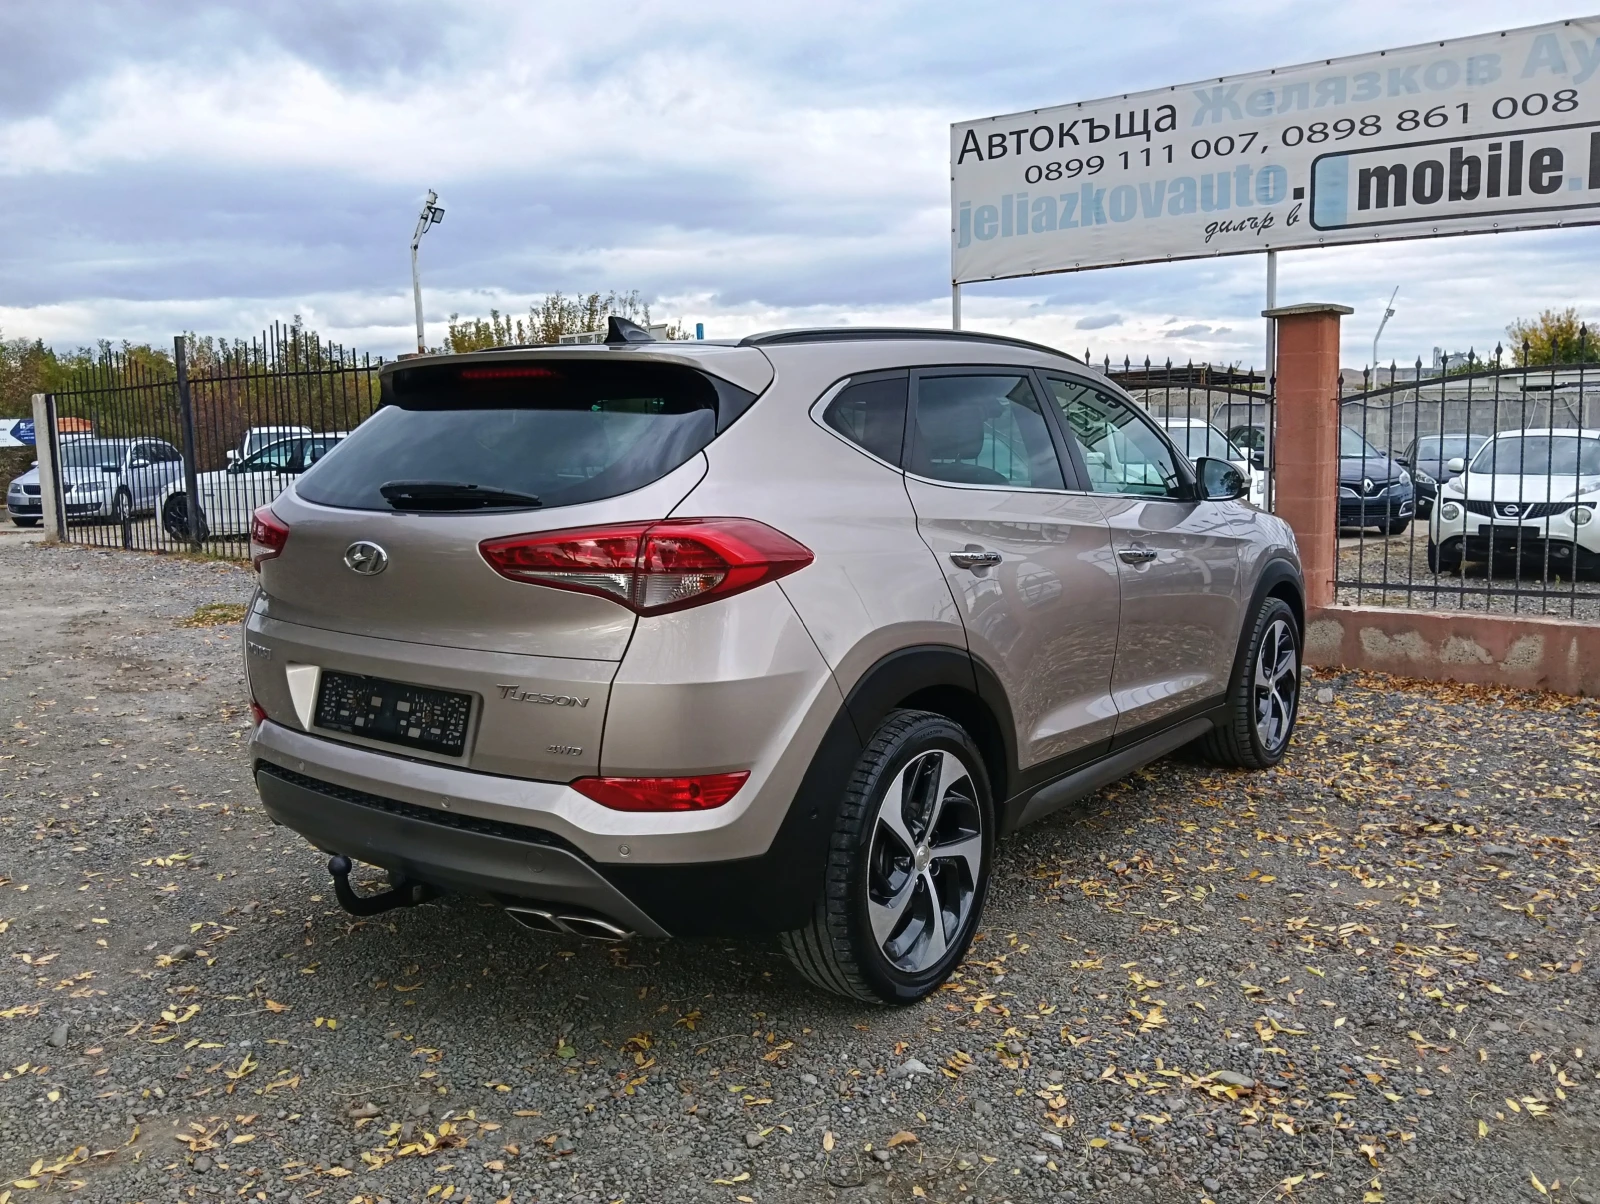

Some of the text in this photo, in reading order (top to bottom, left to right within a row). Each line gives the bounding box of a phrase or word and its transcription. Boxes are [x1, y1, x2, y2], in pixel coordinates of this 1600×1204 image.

[957, 103, 1177, 165] Автокъща
[1191, 53, 1502, 127] Желязков
[1024, 88, 1579, 184] 0899 111 007, 0898 861 008
[1204, 211, 1275, 243] дилър
[546, 744, 583, 757] 4WD
